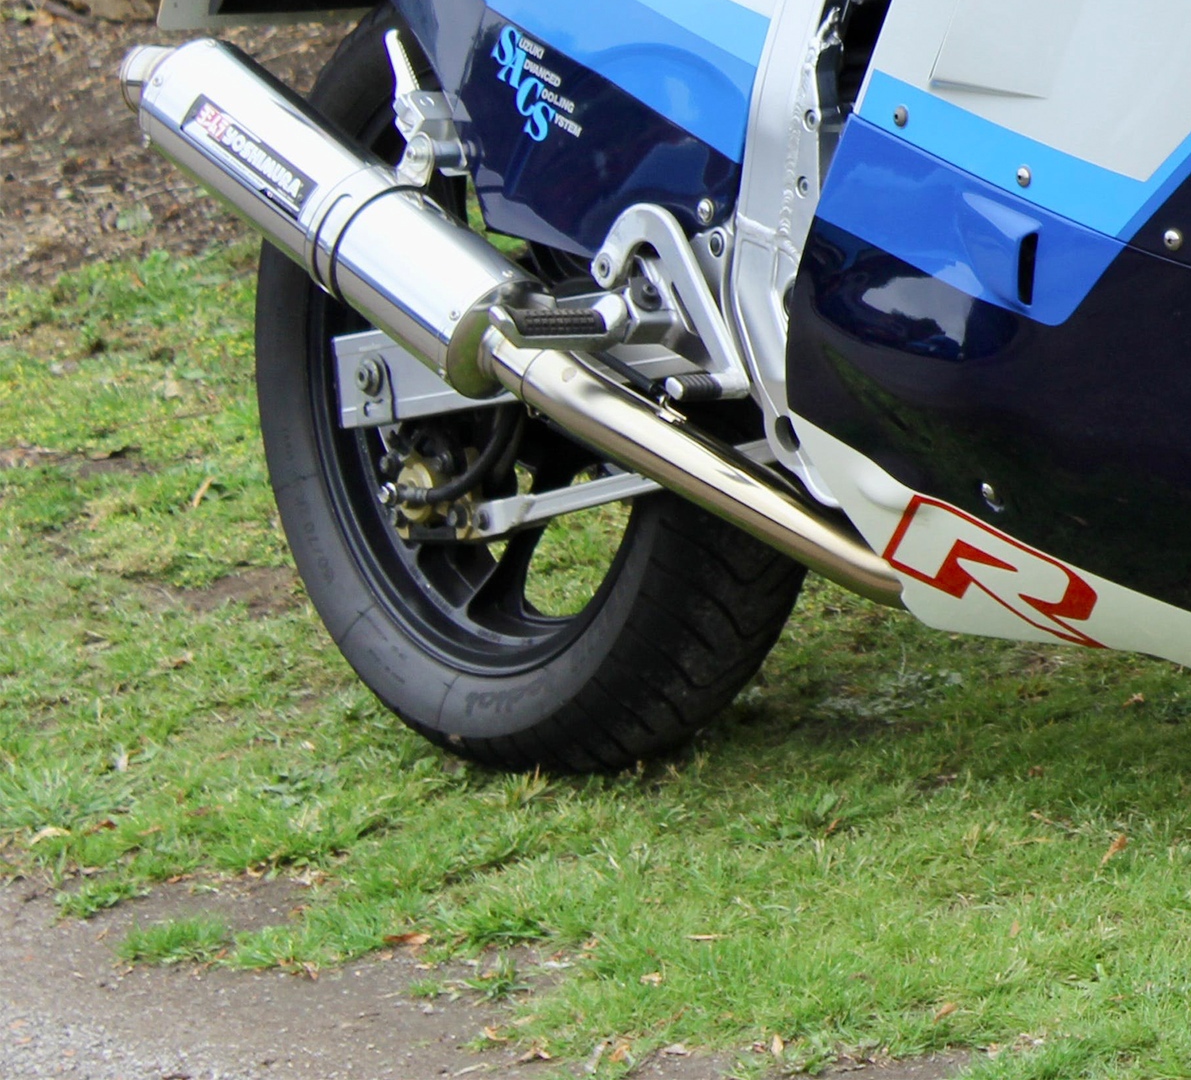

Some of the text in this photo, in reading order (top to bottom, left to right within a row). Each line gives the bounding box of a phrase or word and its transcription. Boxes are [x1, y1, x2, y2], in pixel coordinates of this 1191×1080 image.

[491, 25, 544, 66] SUZUKI
[497, 48, 562, 87] ADVANCED
[516, 80, 575, 114] COOLING
[524, 109, 583, 142] SYSTEM
[222, 125, 302, 198] YOSHIMURA
[882, 494, 1112, 649] R
